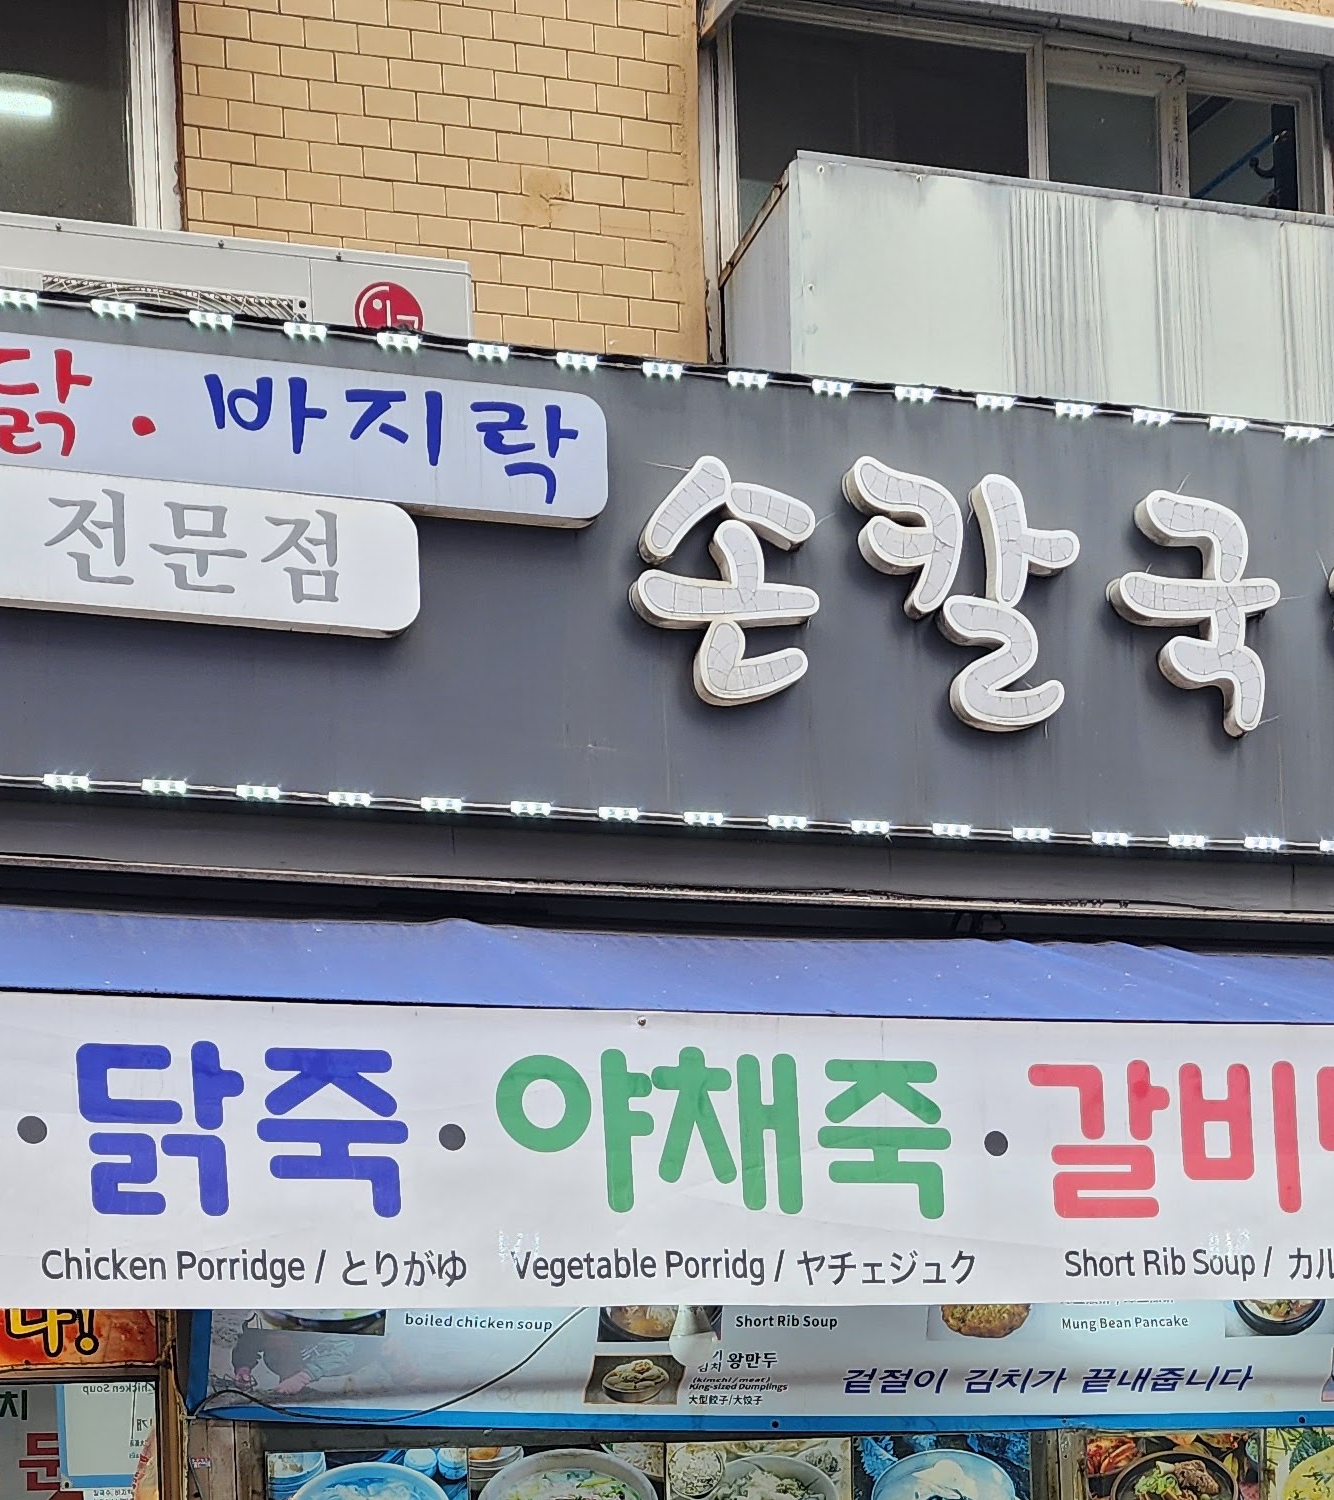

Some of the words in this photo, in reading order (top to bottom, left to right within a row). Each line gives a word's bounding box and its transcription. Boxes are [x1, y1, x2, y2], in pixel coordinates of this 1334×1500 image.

[205, 370, 578, 505] 바지락
[45, 492, 342, 605] 전문점
[72, 1039, 409, 1220] 닭죽
[495, 1046, 952, 1220] 야채죽
[40, 1247, 171, 1284] Chicken
[177, 1248, 305, 1288] Porridge
[338, 1244, 466, 1289] とりがゆ
[512, 1245, 657, 1285] Vegetable
[665, 1248, 766, 1287] Porridg
[797, 1250, 977, 1288] ヤチェジュク
[1063, 1247, 1136, 1279] Short
[1142, 1245, 1184, 1279] Rib
[1192, 1247, 1255, 1286] Soup
[405, 1313, 452, 1327] boiled
[456, 1316, 513, 1329] chicken
[517, 1320, 552, 1332] soup
[736, 1315, 774, 1327] Short
[778, 1315, 799, 1327] Rib
[803, 1316, 838, 1329] Soup
[1062, 1318, 1096, 1331] Mung
[1100, 1318, 1131, 1328] Bean
[1135, 1315, 1189, 1328] Pancake
[727, 1352, 777, 1369] 왕만두
[689, 1383, 736, 1391] King-sized
[738, 1383, 788, 1392] Dumplings
[842, 1368, 948, 1394] 겉절이
[965, 1367, 1067, 1394] 김치가
[1082, 1365, 1253, 1393] 끝내줍니다
